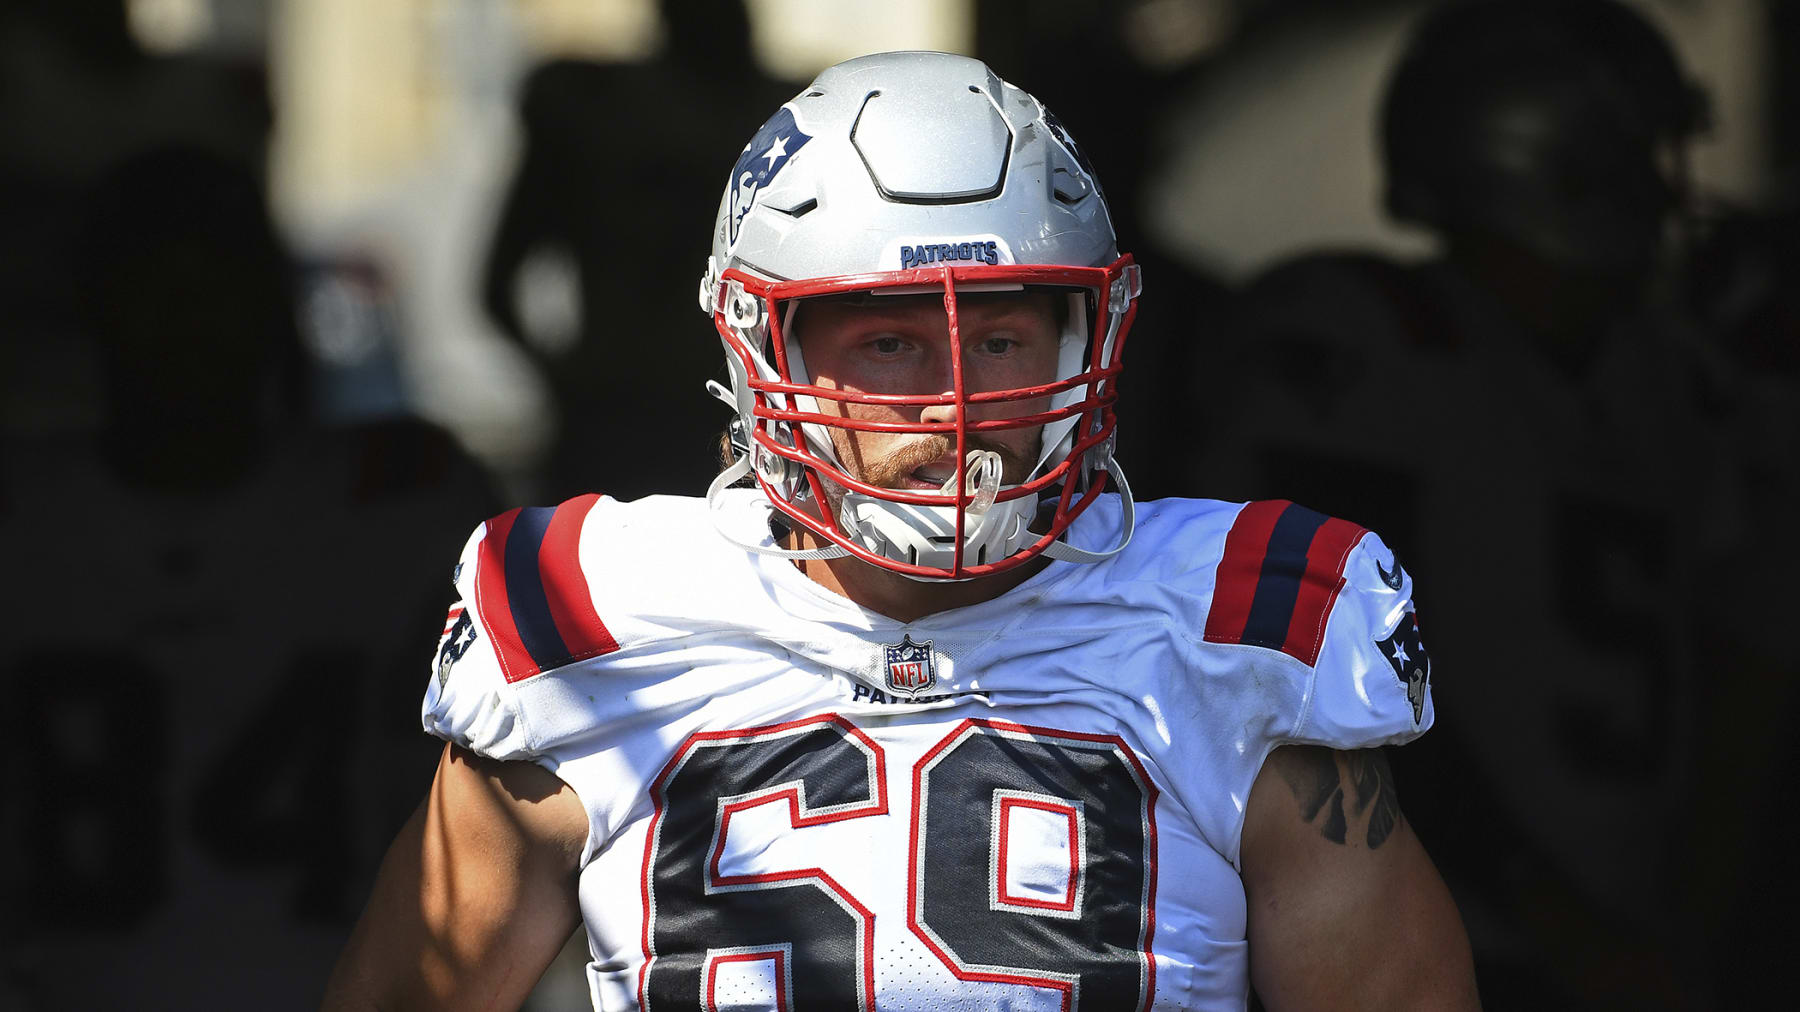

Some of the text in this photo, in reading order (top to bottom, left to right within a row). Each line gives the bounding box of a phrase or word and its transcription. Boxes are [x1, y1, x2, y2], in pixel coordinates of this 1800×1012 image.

[901, 241, 998, 270] PATRIOTS
[891, 662, 928, 687] NFL
[638, 713, 1159, 1012] 69
